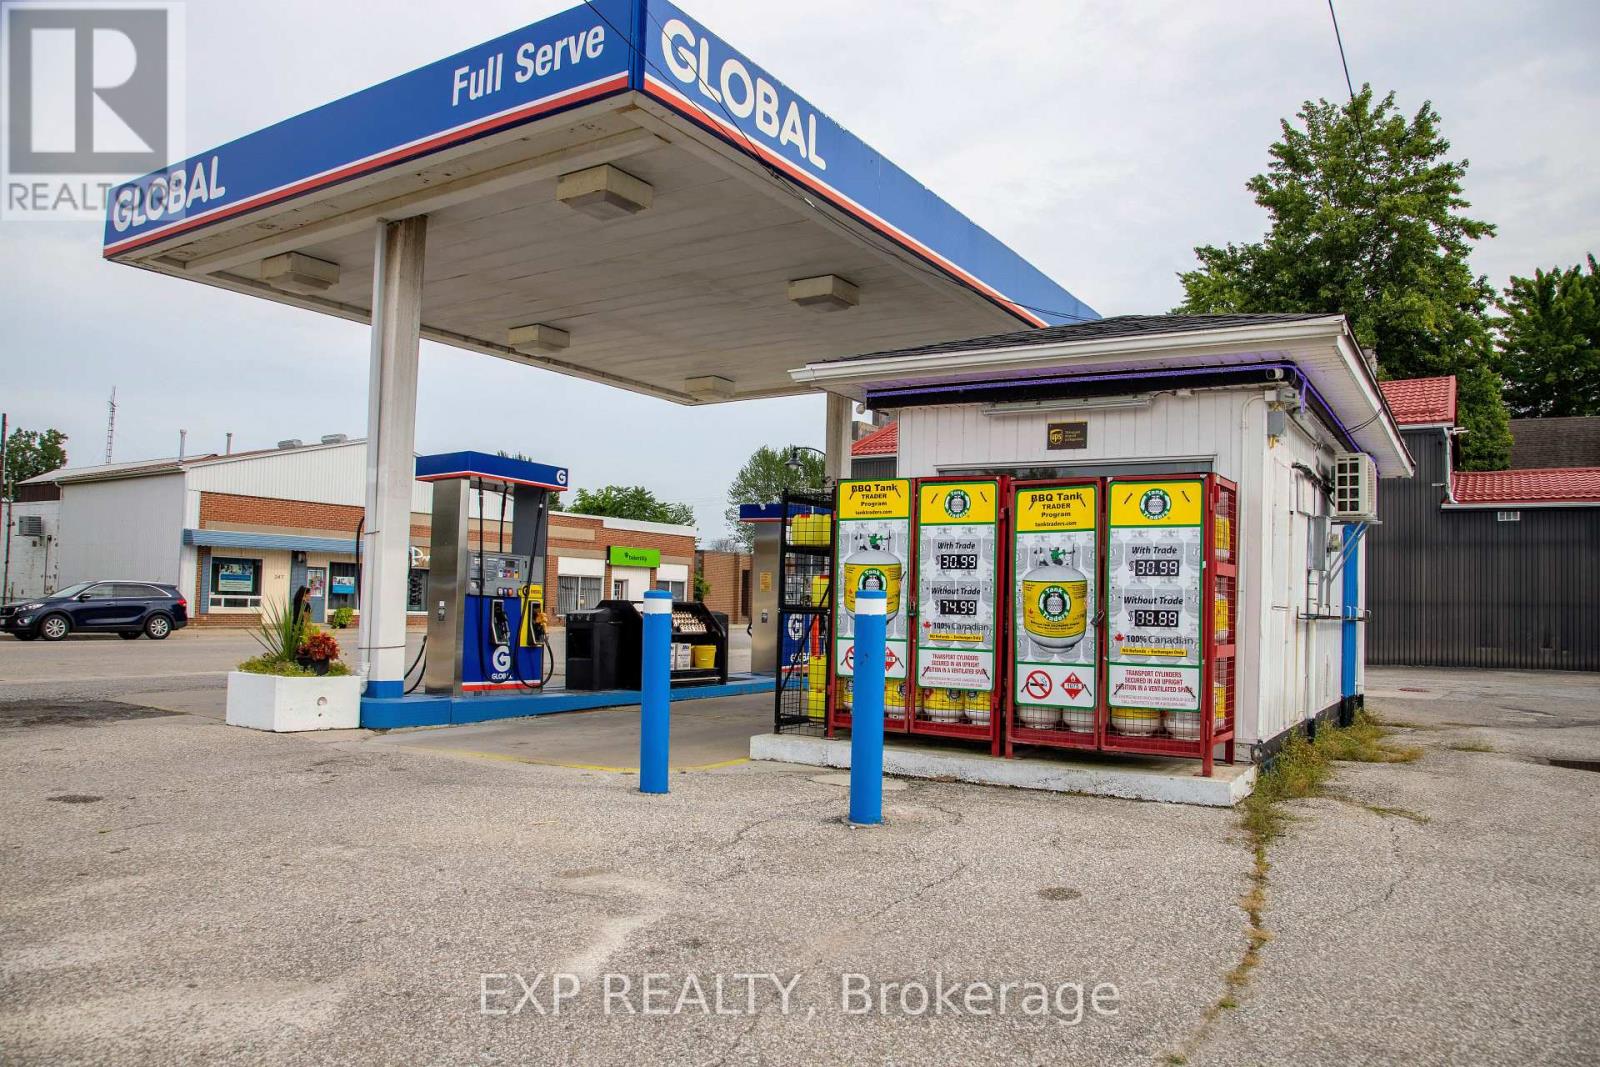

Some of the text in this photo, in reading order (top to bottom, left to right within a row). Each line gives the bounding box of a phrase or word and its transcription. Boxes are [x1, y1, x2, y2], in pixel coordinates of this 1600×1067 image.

[452, 25, 605, 107] Full Serve
[661, 18, 827, 171] GLOBAL
[113, 155, 226, 232] GLOBAL
[556, 469, 566, 485] G
[851, 483, 897, 494] BBQ Tank
[1031, 492, 1083, 502] BBQ Tank
[1041, 511, 1071, 519] Program
[937, 542, 976, 550] With Trade
[1131, 546, 1177, 554] With Trade
[931, 587, 981, 595] Without Trade
[1124, 596, 1184, 605] Without Trade
[933, 622, 989, 631] 100% Canadian
[1126, 635, 1194, 645] 100% Canadian
[492, 645, 511, 672] G
[1148, 685, 1177, 693] VENTILATED
